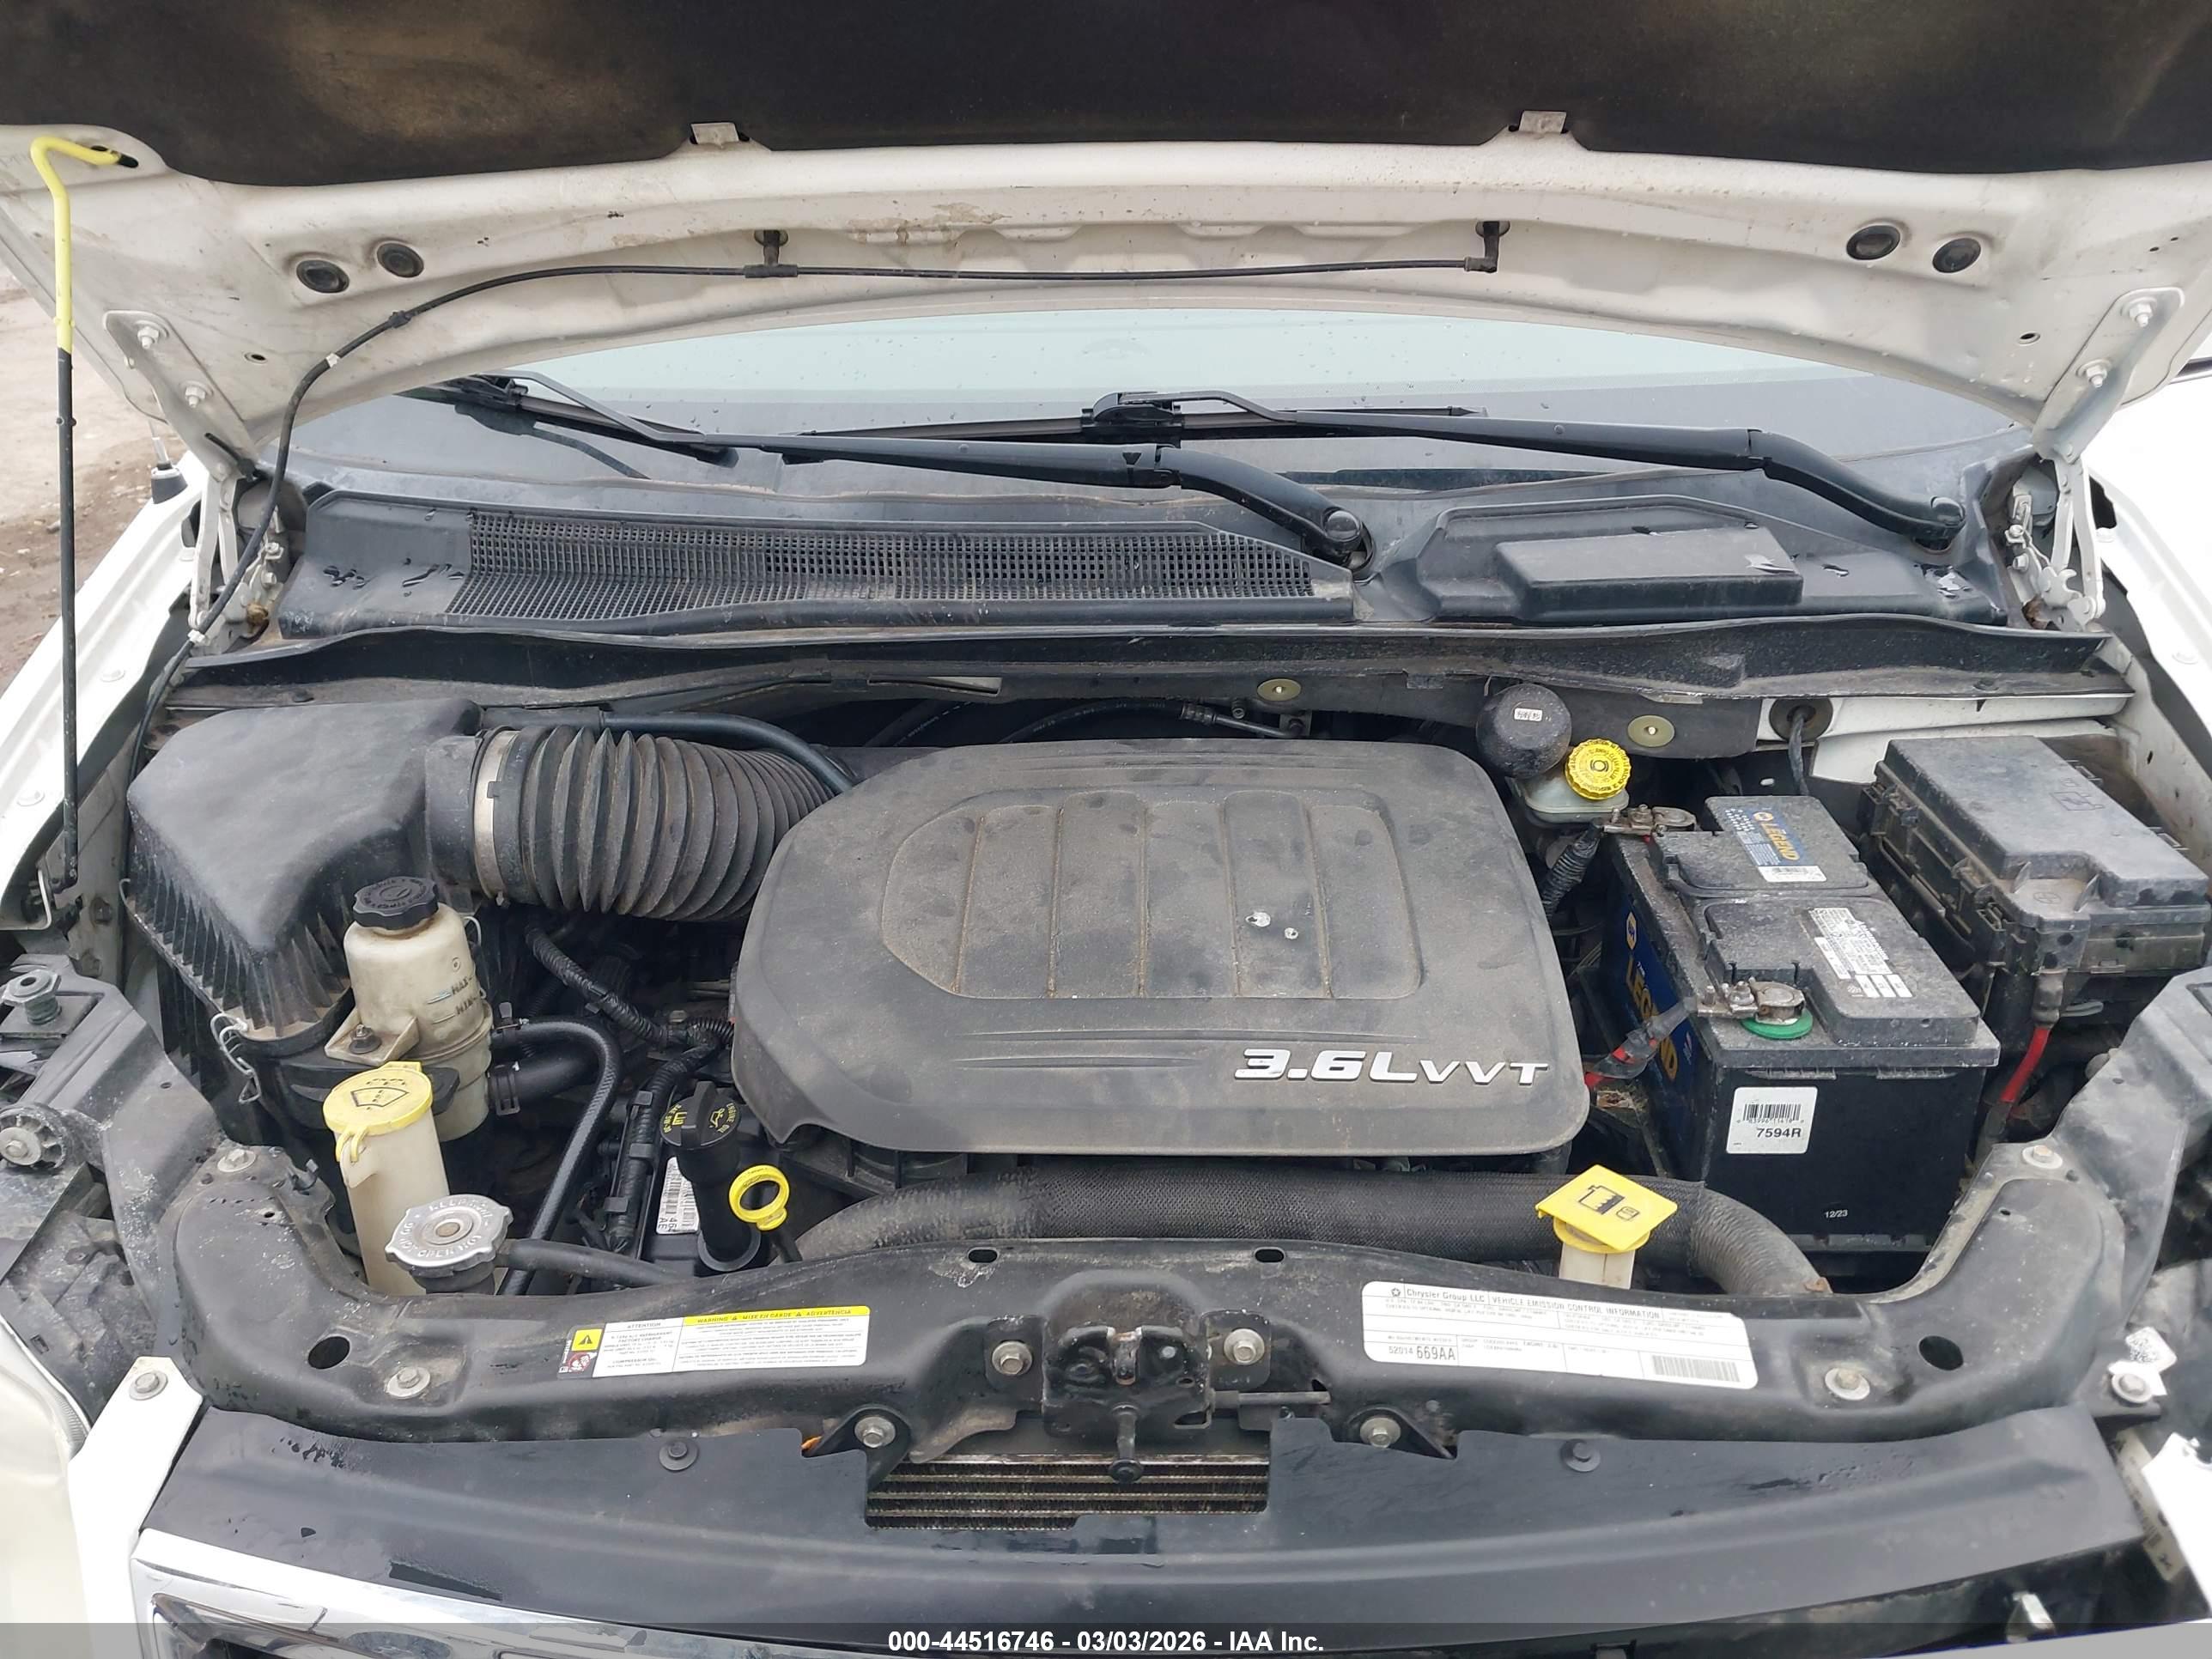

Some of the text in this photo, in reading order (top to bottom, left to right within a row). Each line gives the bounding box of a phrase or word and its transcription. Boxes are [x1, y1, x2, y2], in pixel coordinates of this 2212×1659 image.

[1760, 822, 1800, 860] LEGEND
[716, 1124, 731, 1133] OIL
[1756, 1127, 1802, 1138] 7594R
[1824, 1209, 1848, 1218] 12/23
[1407, 1288, 1440, 1299] Chrysler
[1443, 1292, 1468, 1302] Group
[1492, 1297, 1524, 1306] VEHICLE
[1567, 1304, 1602, 1314] CONTROL
[1606, 1307, 1661, 1319] INFORMATION
[1416, 1346, 1456, 1360] 669AA
